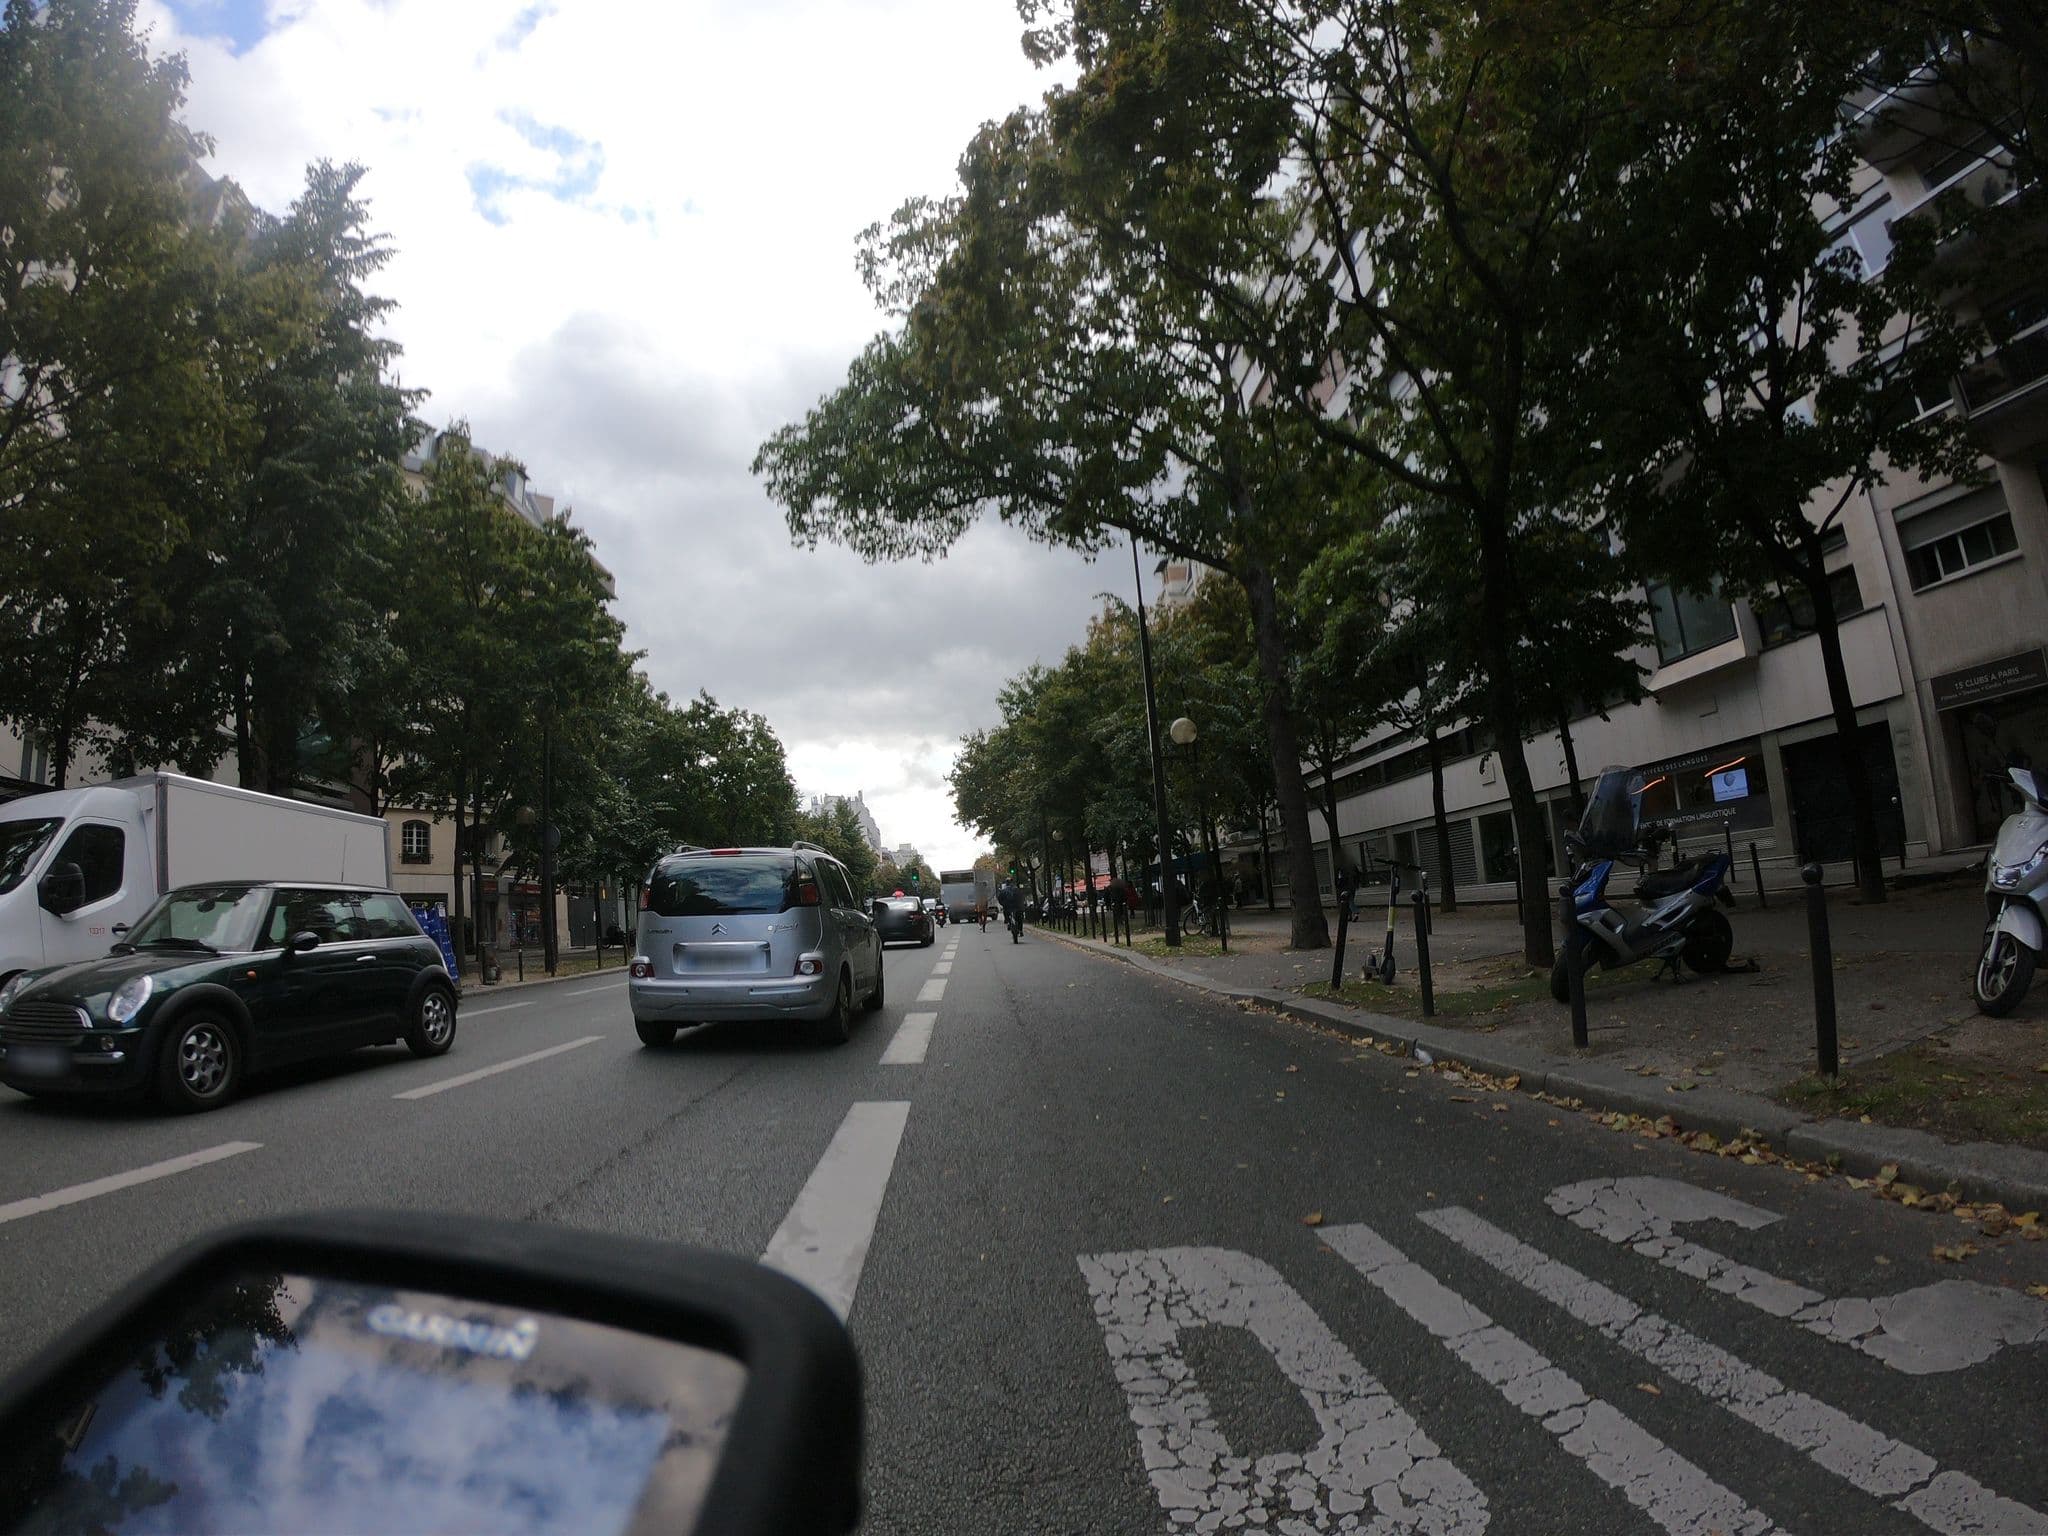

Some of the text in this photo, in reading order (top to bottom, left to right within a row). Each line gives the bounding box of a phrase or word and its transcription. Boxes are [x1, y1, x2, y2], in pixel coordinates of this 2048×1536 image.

[1965, 674, 1990, 688] CLUBS
[1998, 666, 2020, 679] PARIS
[1664, 814, 1696, 826] FORMATION
[1696, 808, 1737, 821] LINGUISTIQUE
[366, 1303, 539, 1360] GARMIN
